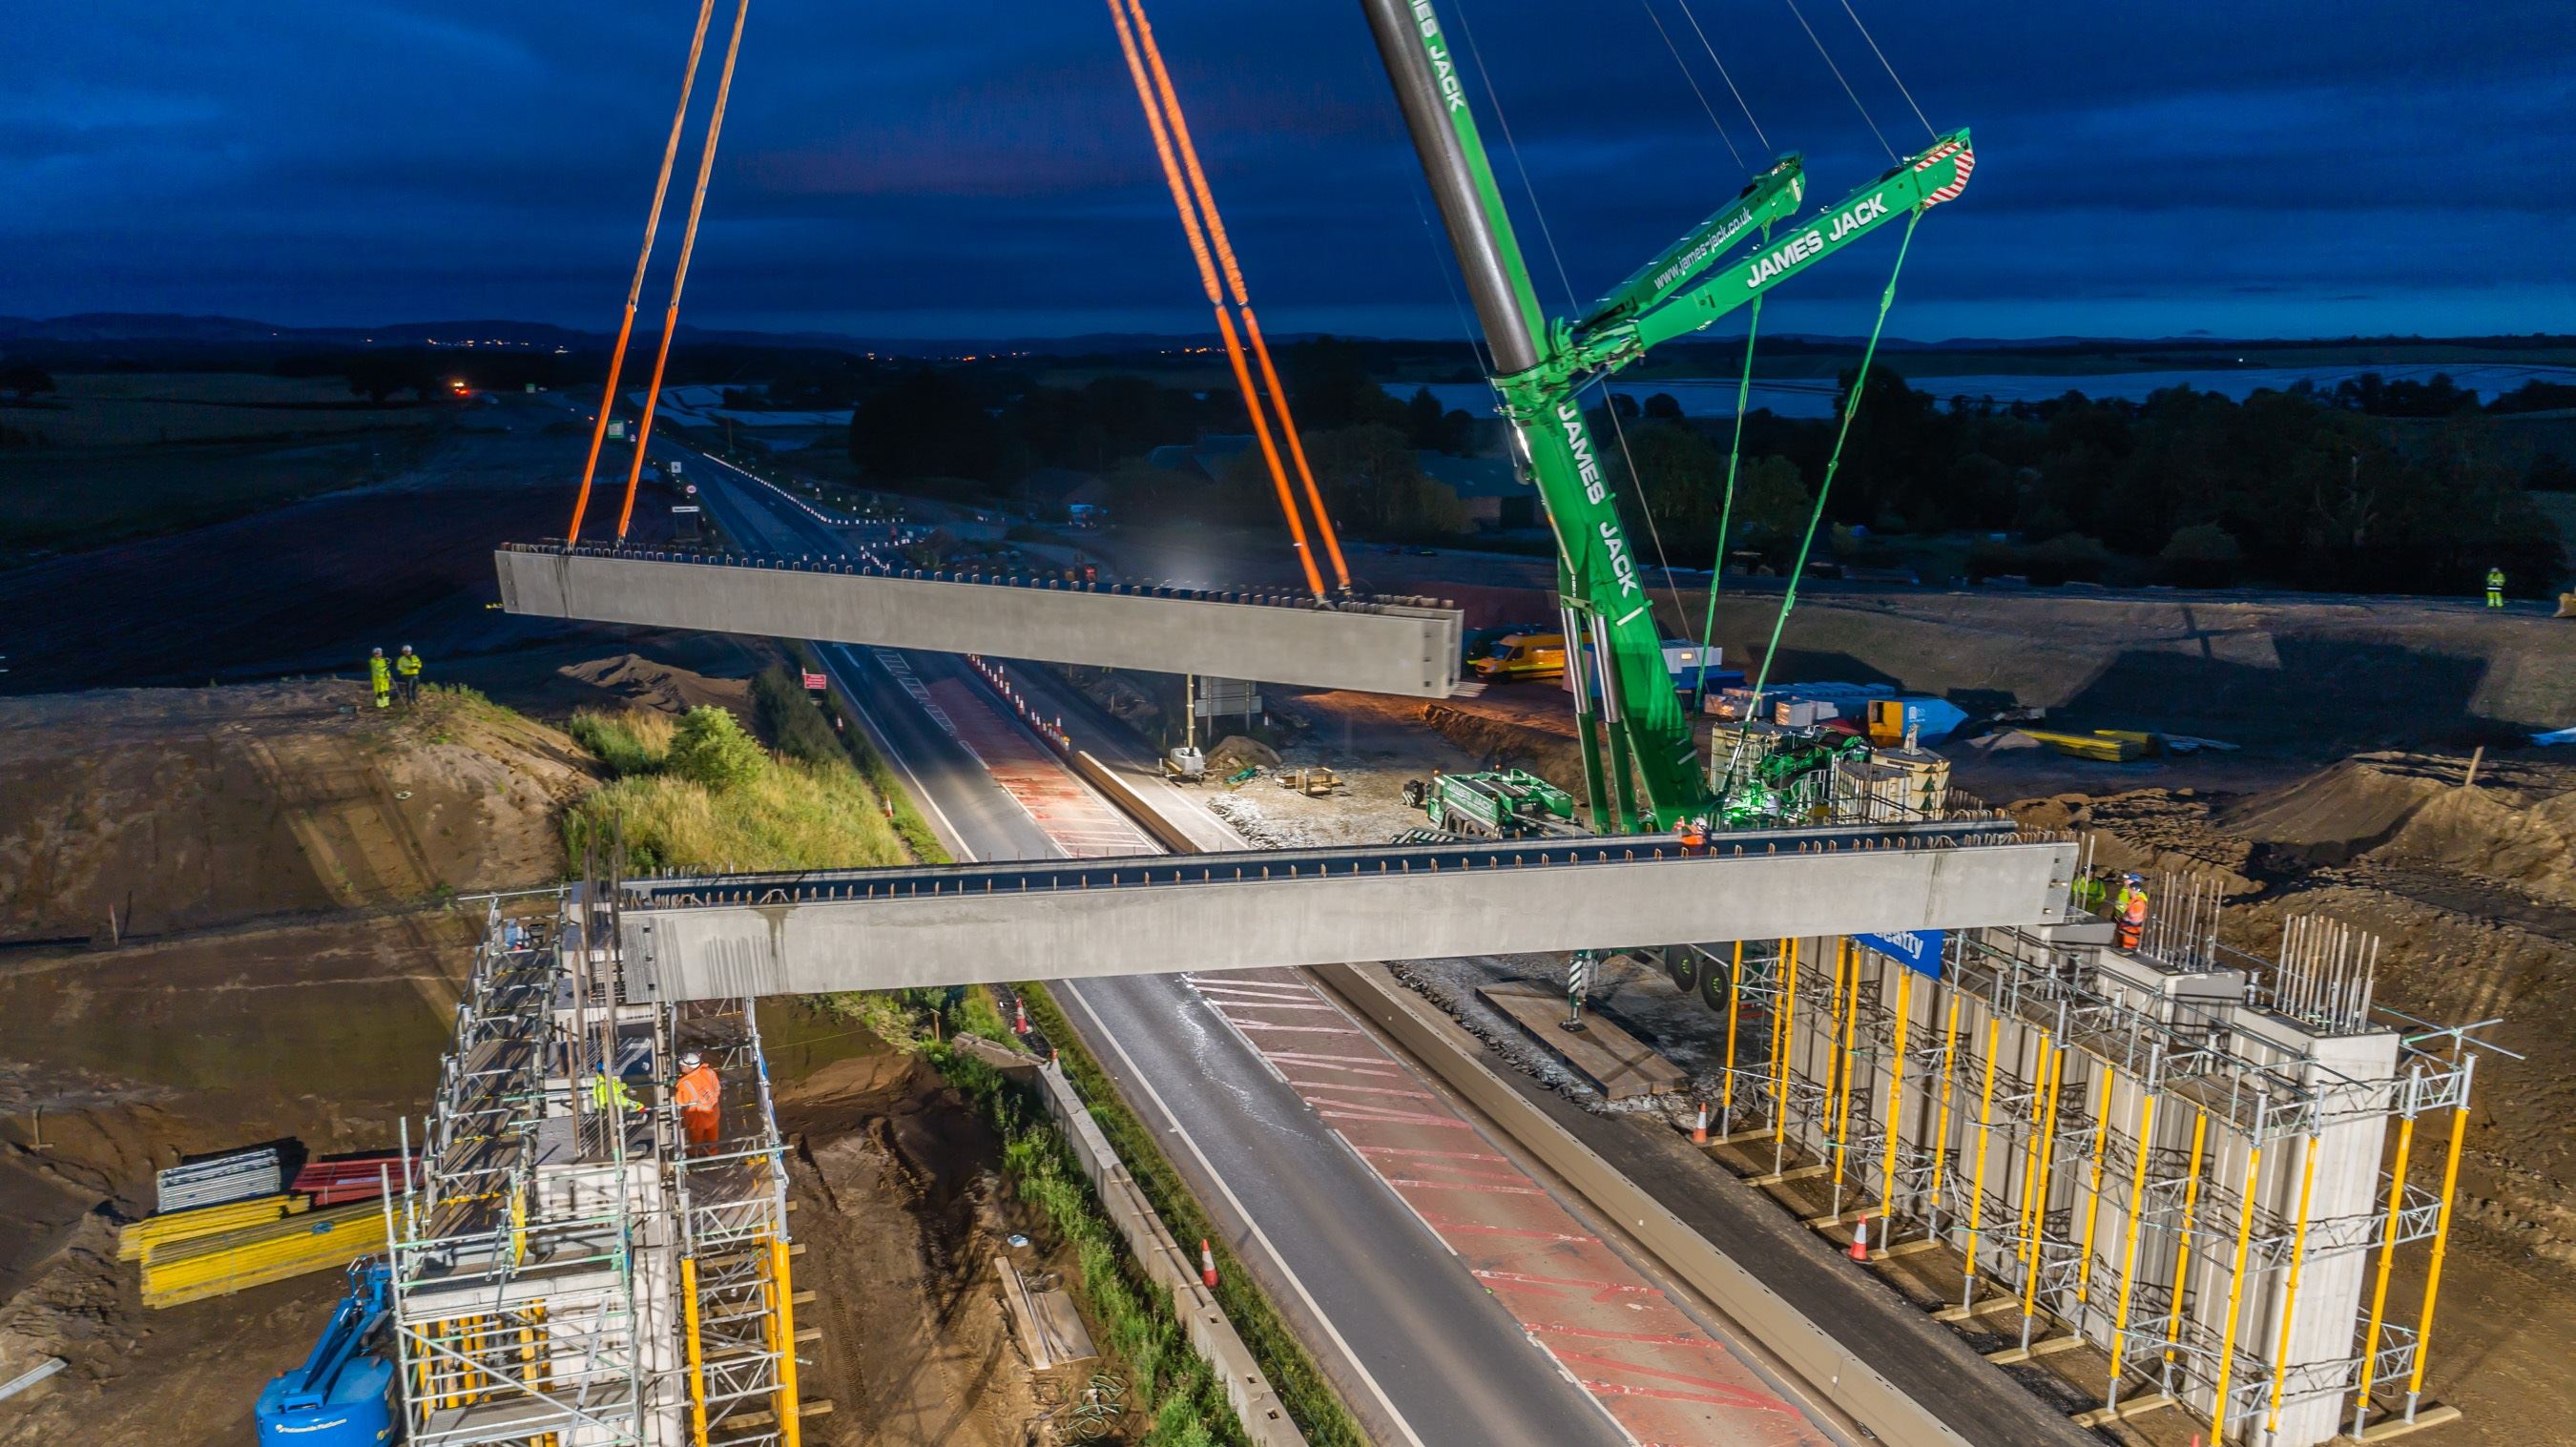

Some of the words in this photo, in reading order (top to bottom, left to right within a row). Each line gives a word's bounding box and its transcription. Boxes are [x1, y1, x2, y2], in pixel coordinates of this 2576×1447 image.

[1430, 46, 1465, 113] JACK
[1653, 207, 1753, 290] www.james-jack.co.uk
[1747, 229, 1824, 288] JAMES
[1828, 193, 1889, 242] JACK
[1557, 405, 1606, 506] JAMES
[1599, 522, 1638, 598] JACK
